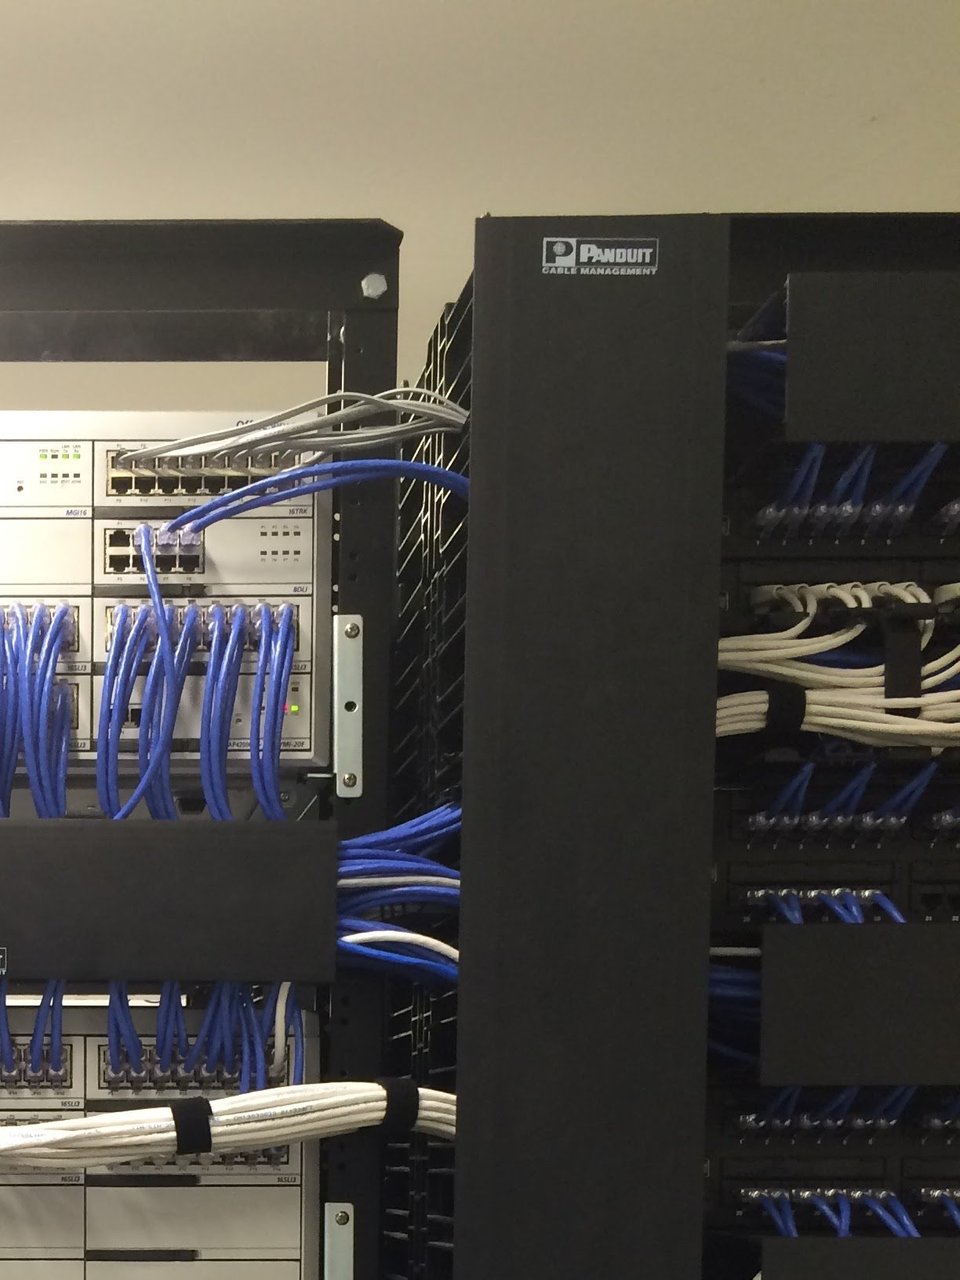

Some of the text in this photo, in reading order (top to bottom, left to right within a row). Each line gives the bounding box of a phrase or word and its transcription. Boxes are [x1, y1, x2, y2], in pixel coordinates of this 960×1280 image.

[580, 244, 653, 263] PANDUIT
[542, 267, 658, 276] CABLE MANAGEMENT
